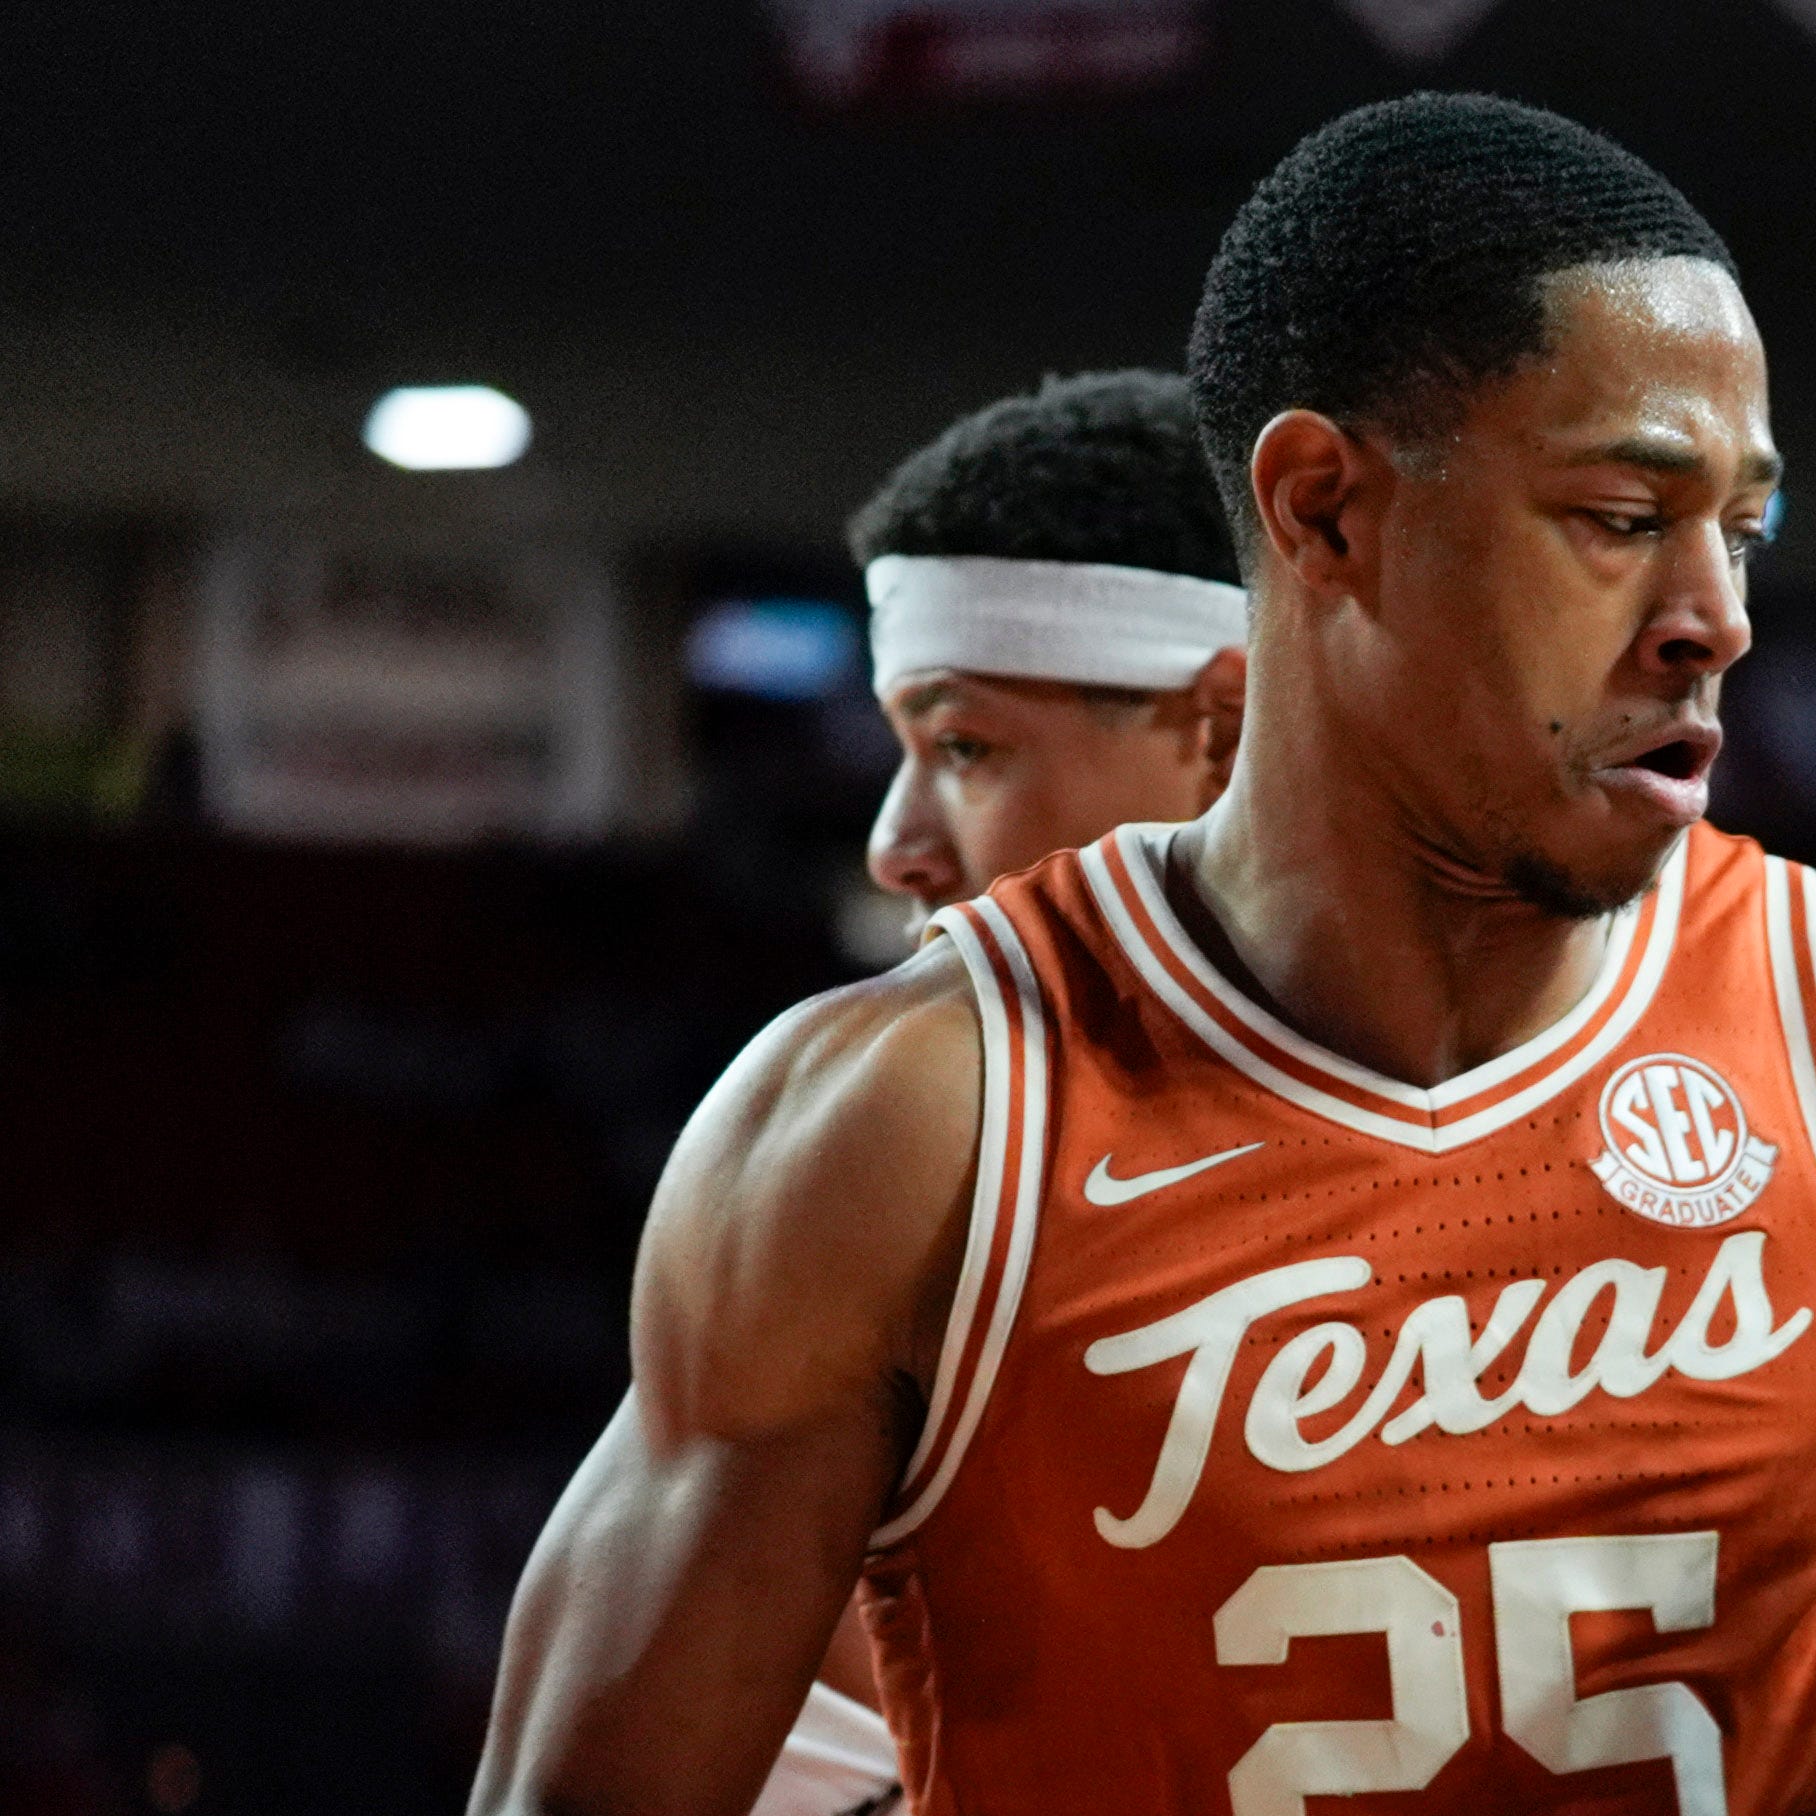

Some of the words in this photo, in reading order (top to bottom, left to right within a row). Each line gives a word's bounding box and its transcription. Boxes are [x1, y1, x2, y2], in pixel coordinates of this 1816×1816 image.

[1611, 1066, 1734, 1182] SEC
[1619, 1169, 1761, 1225] GRADUATE
[1084, 1232, 1812, 1549] Texas
